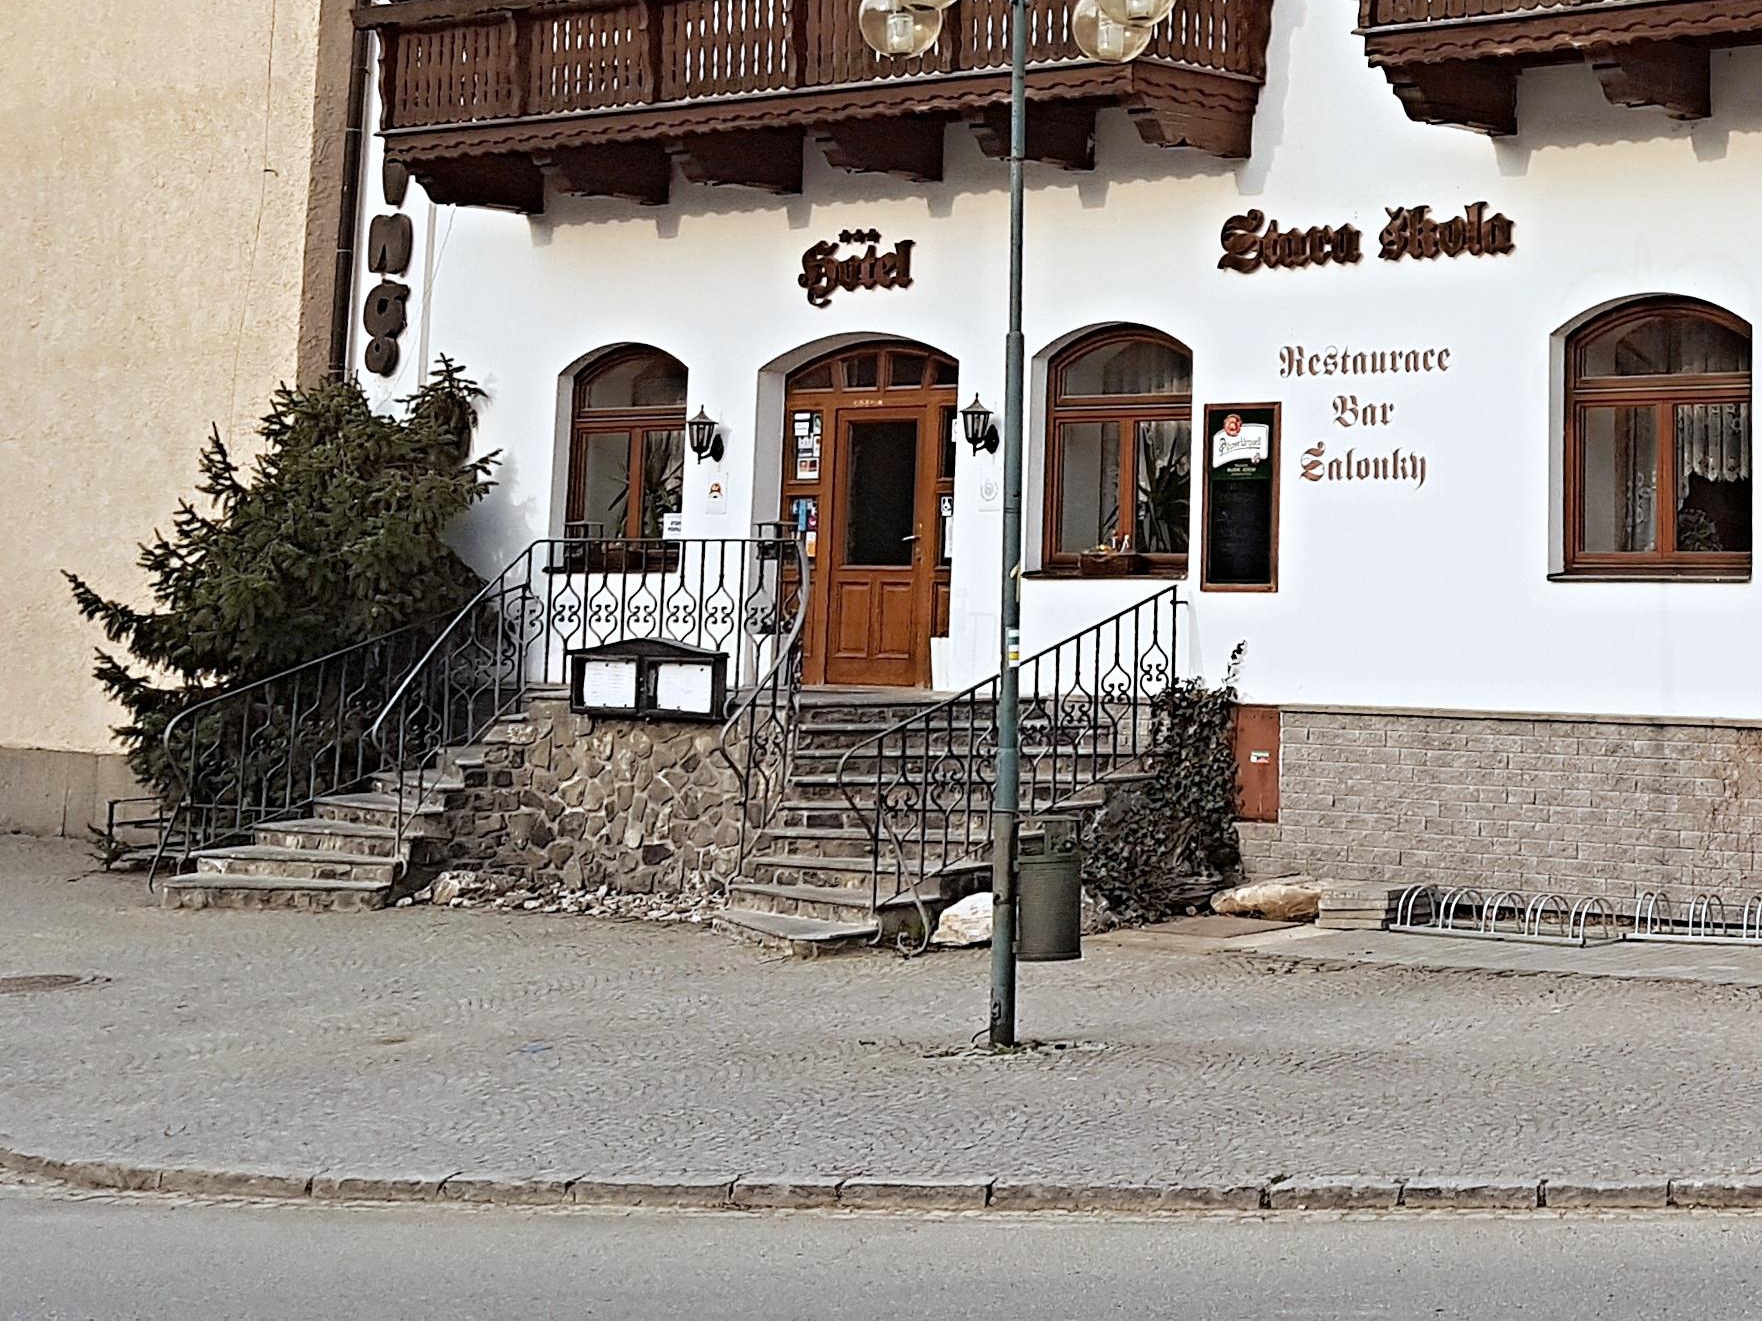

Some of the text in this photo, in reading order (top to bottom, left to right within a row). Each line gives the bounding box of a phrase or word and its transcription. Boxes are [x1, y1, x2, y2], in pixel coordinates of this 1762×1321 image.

[1217, 208, 1363, 274] Stara
[798, 239, 916, 309] Hotel
[1279, 345, 1452, 378] Restaurace
[1332, 395, 1395, 428] Bar
[1299, 441, 1428, 490] Salonky
